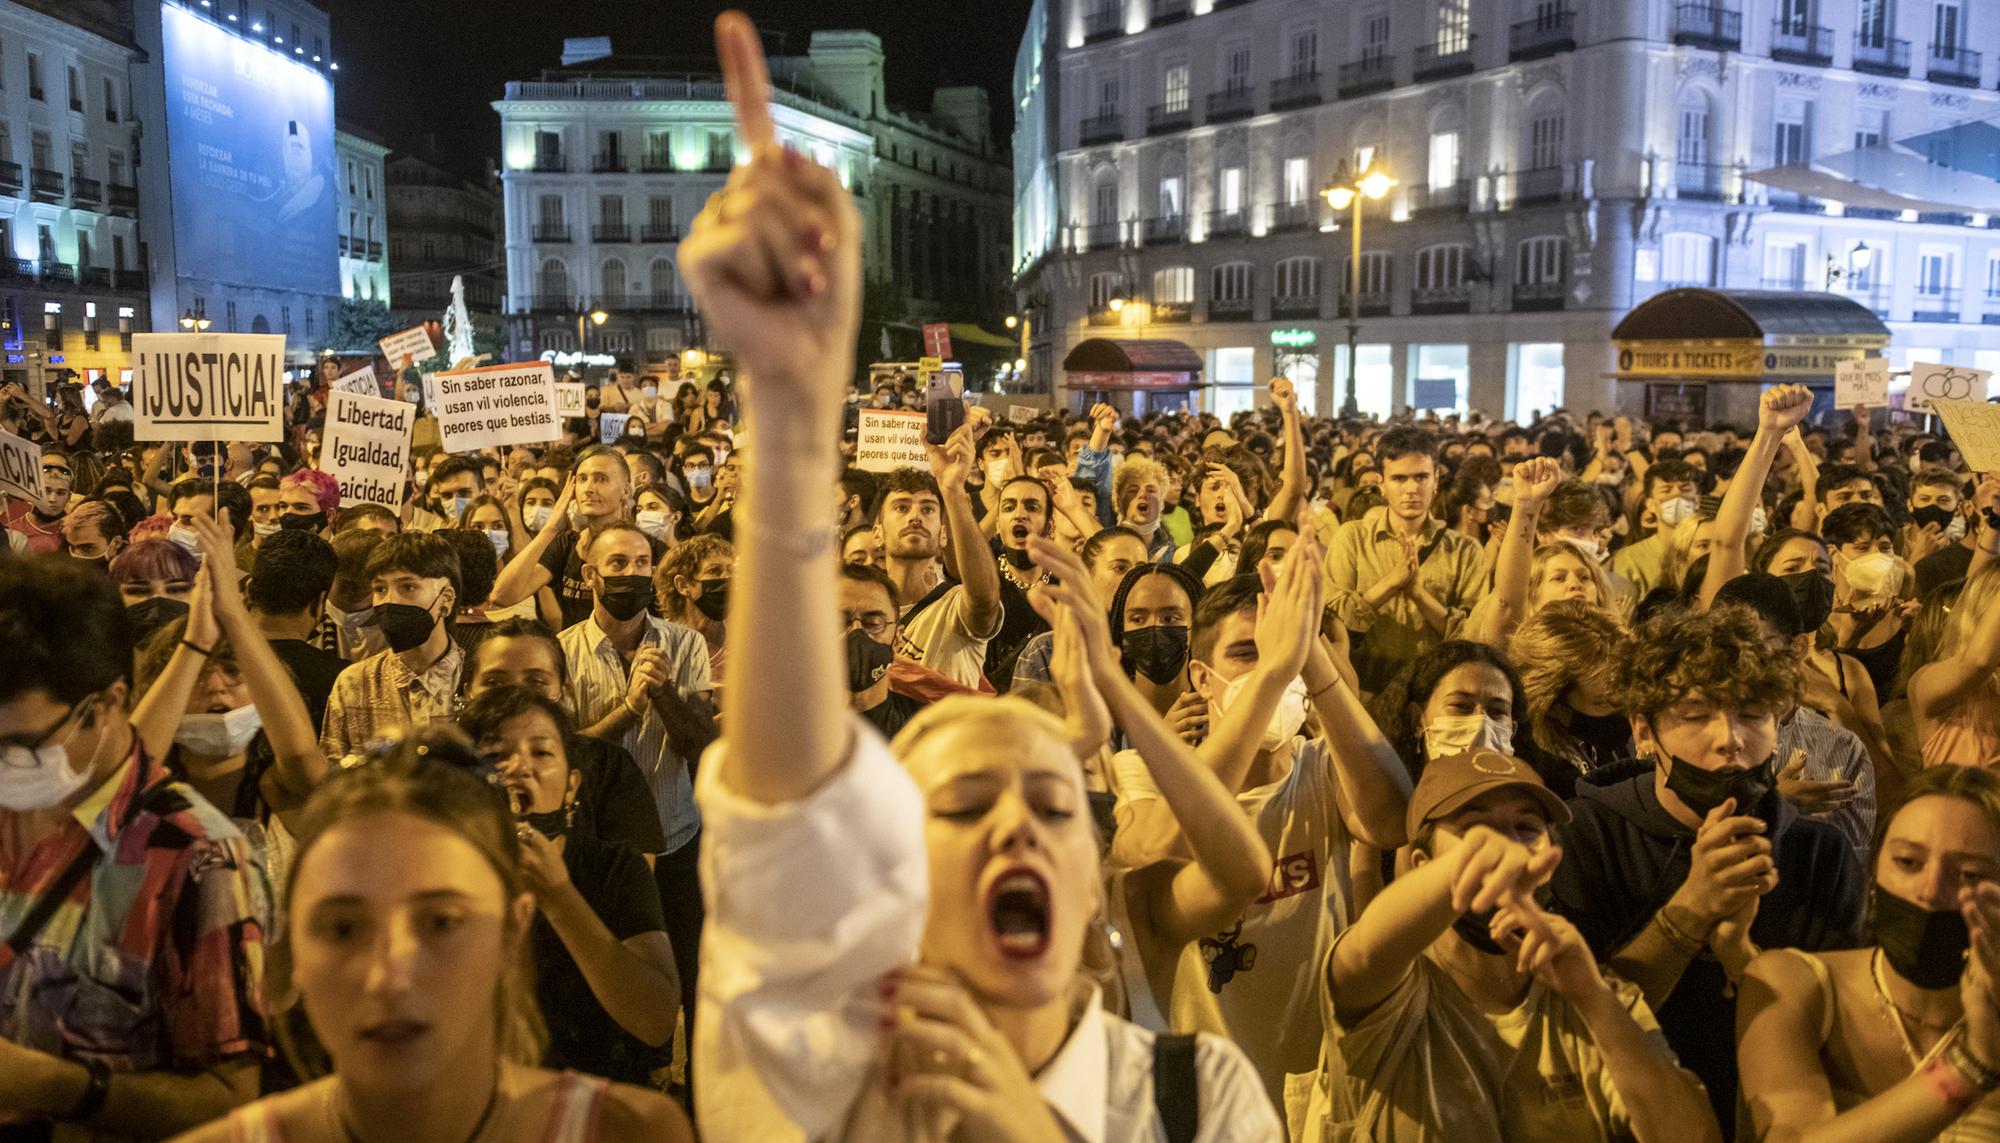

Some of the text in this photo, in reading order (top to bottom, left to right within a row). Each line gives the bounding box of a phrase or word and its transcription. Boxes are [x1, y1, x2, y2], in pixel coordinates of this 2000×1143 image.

[1634, 352, 1732, 369] TOURS & TICKETS
[1779, 355, 1809, 368] TOURS
[1811, 355, 1819, 368] &
[1853, 361, 1866, 370] NO
[140, 352, 276, 417] ¡JUSTICIA!
[441, 380, 462, 394] Sin
[464, 377, 496, 392] saber
[499, 373, 546, 388] razonar,
[1840, 371, 1881, 383] QUEREMOS
[445, 391, 548, 415] usan vil violencia,
[337, 399, 407, 437] Libertad,
[443, 412, 555, 438] peores que bestias.
[865, 416, 879, 428] Sin
[881, 417, 906, 429] saber
[864, 434, 885, 444] usan
[887, 433, 898, 444] vil
[333, 436, 403, 474] Igualdad,
[860, 450, 889, 461] peores
[890, 451, 907, 462] que
[332, 473, 399, 506] aicidad.
